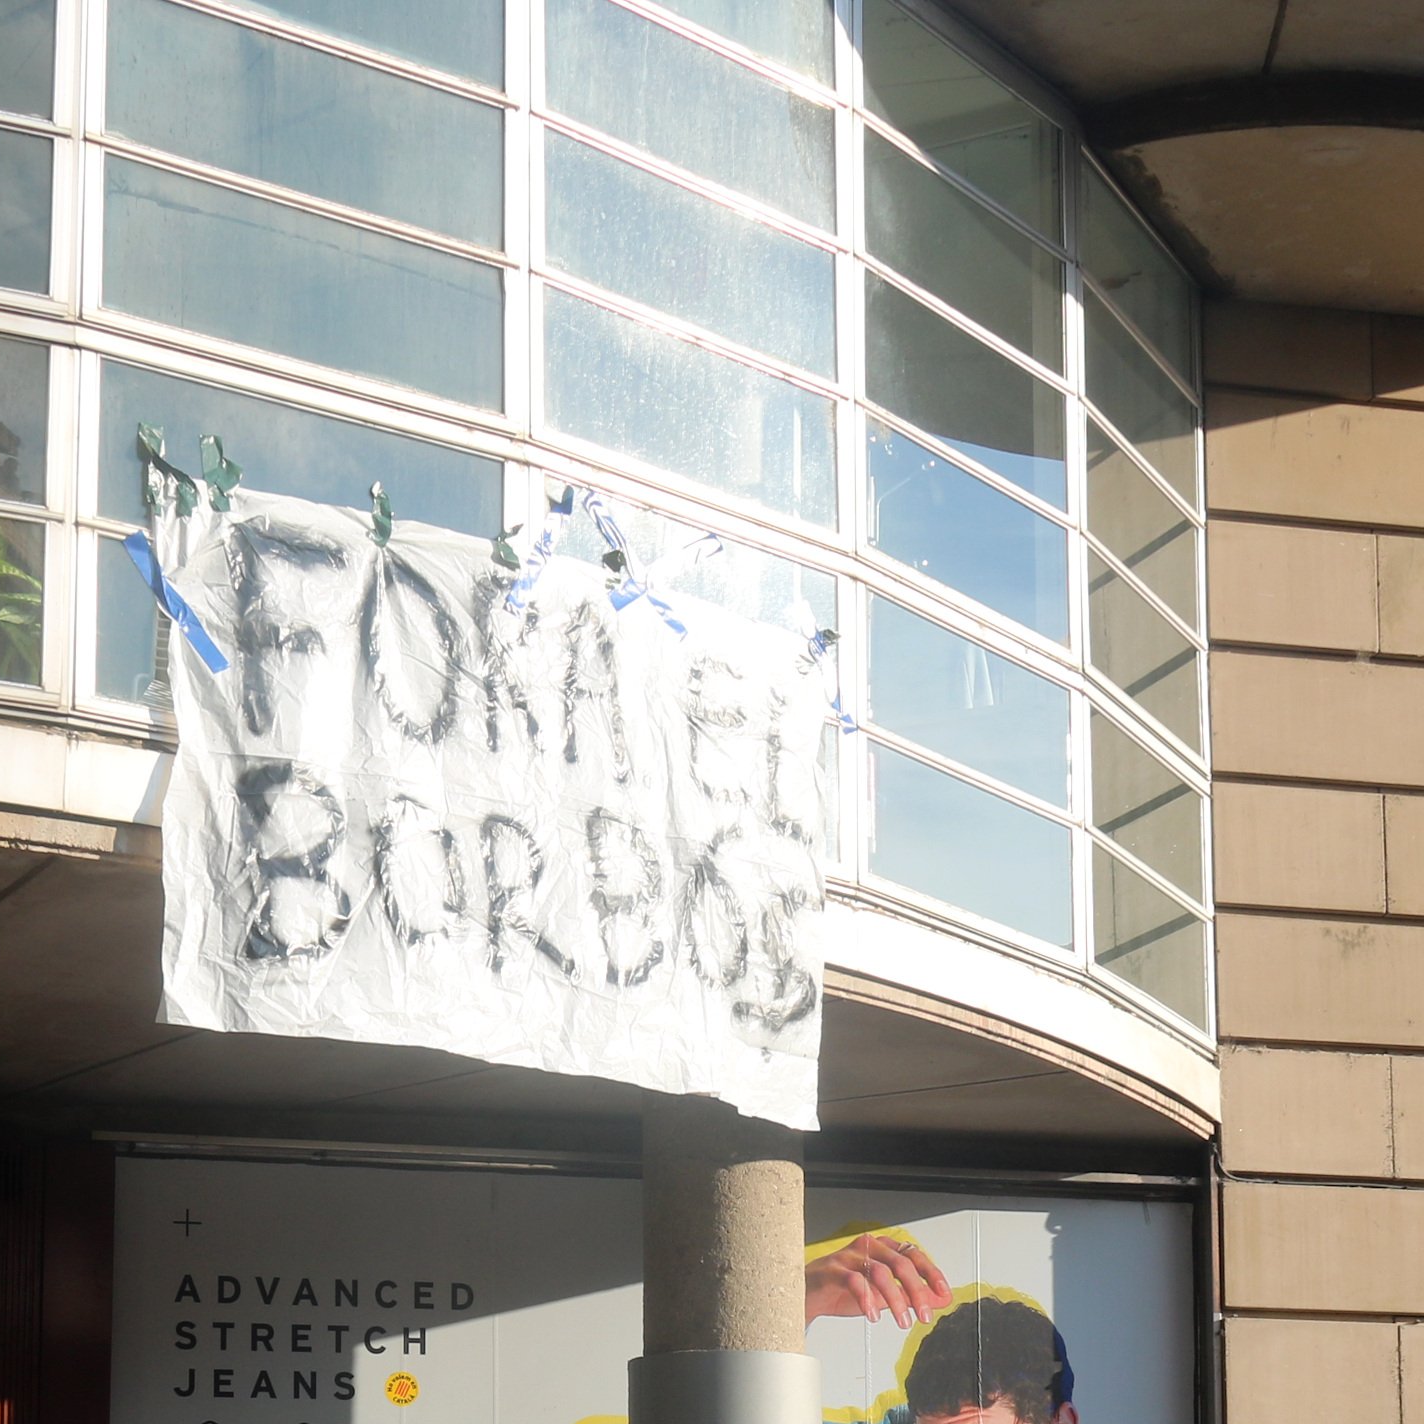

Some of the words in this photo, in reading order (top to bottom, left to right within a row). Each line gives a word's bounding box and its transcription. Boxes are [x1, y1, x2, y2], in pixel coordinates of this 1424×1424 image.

[229, 518, 631, 783] FORA
[174, 1274, 474, 1311] ADVANCED
[173, 1320, 426, 1355] STRETCH
[173, 1368, 356, 1401] JEANS
